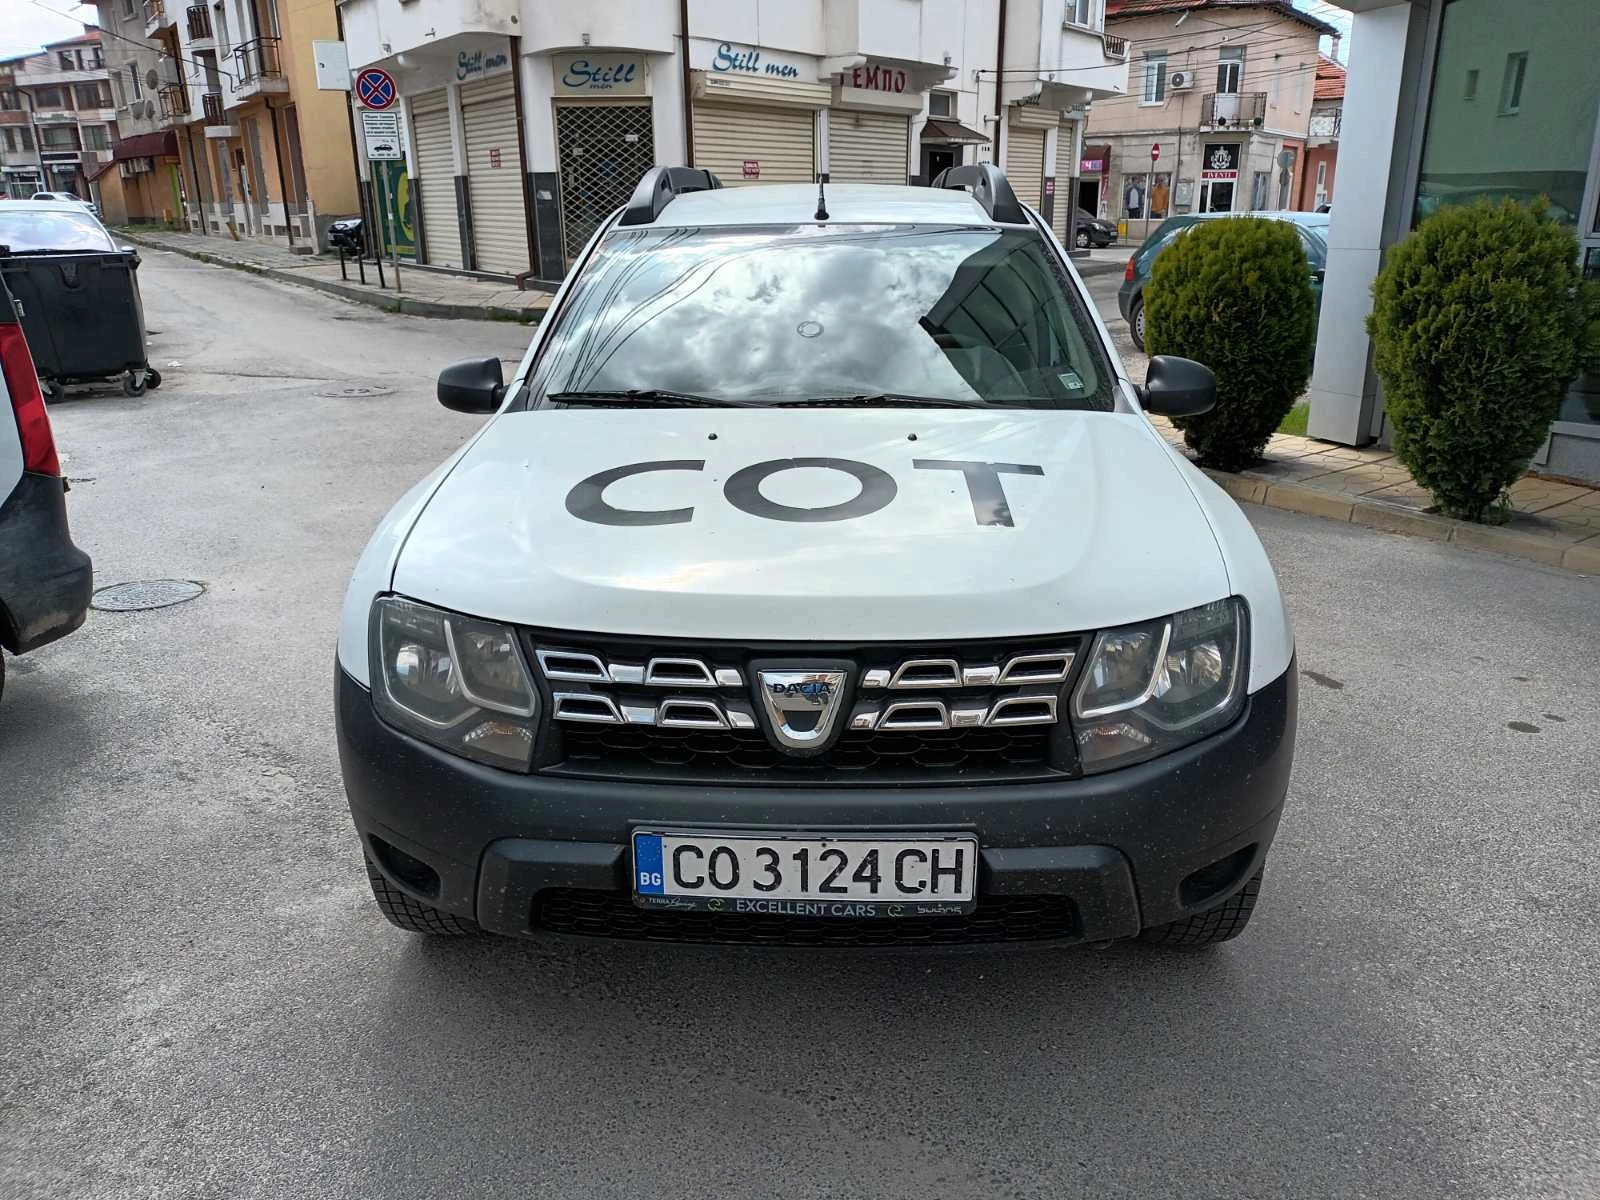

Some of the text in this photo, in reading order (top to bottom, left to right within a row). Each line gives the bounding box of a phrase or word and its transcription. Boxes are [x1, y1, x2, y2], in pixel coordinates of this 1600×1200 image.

[713, 43, 799, 77] Still men
[562, 60, 635, 87] Still
[773, 683, 831, 694] DACIA
[640, 872, 661, 886] BG
[736, 899, 828, 916] EXCELLENT
[831, 904, 876, 917] CARS
